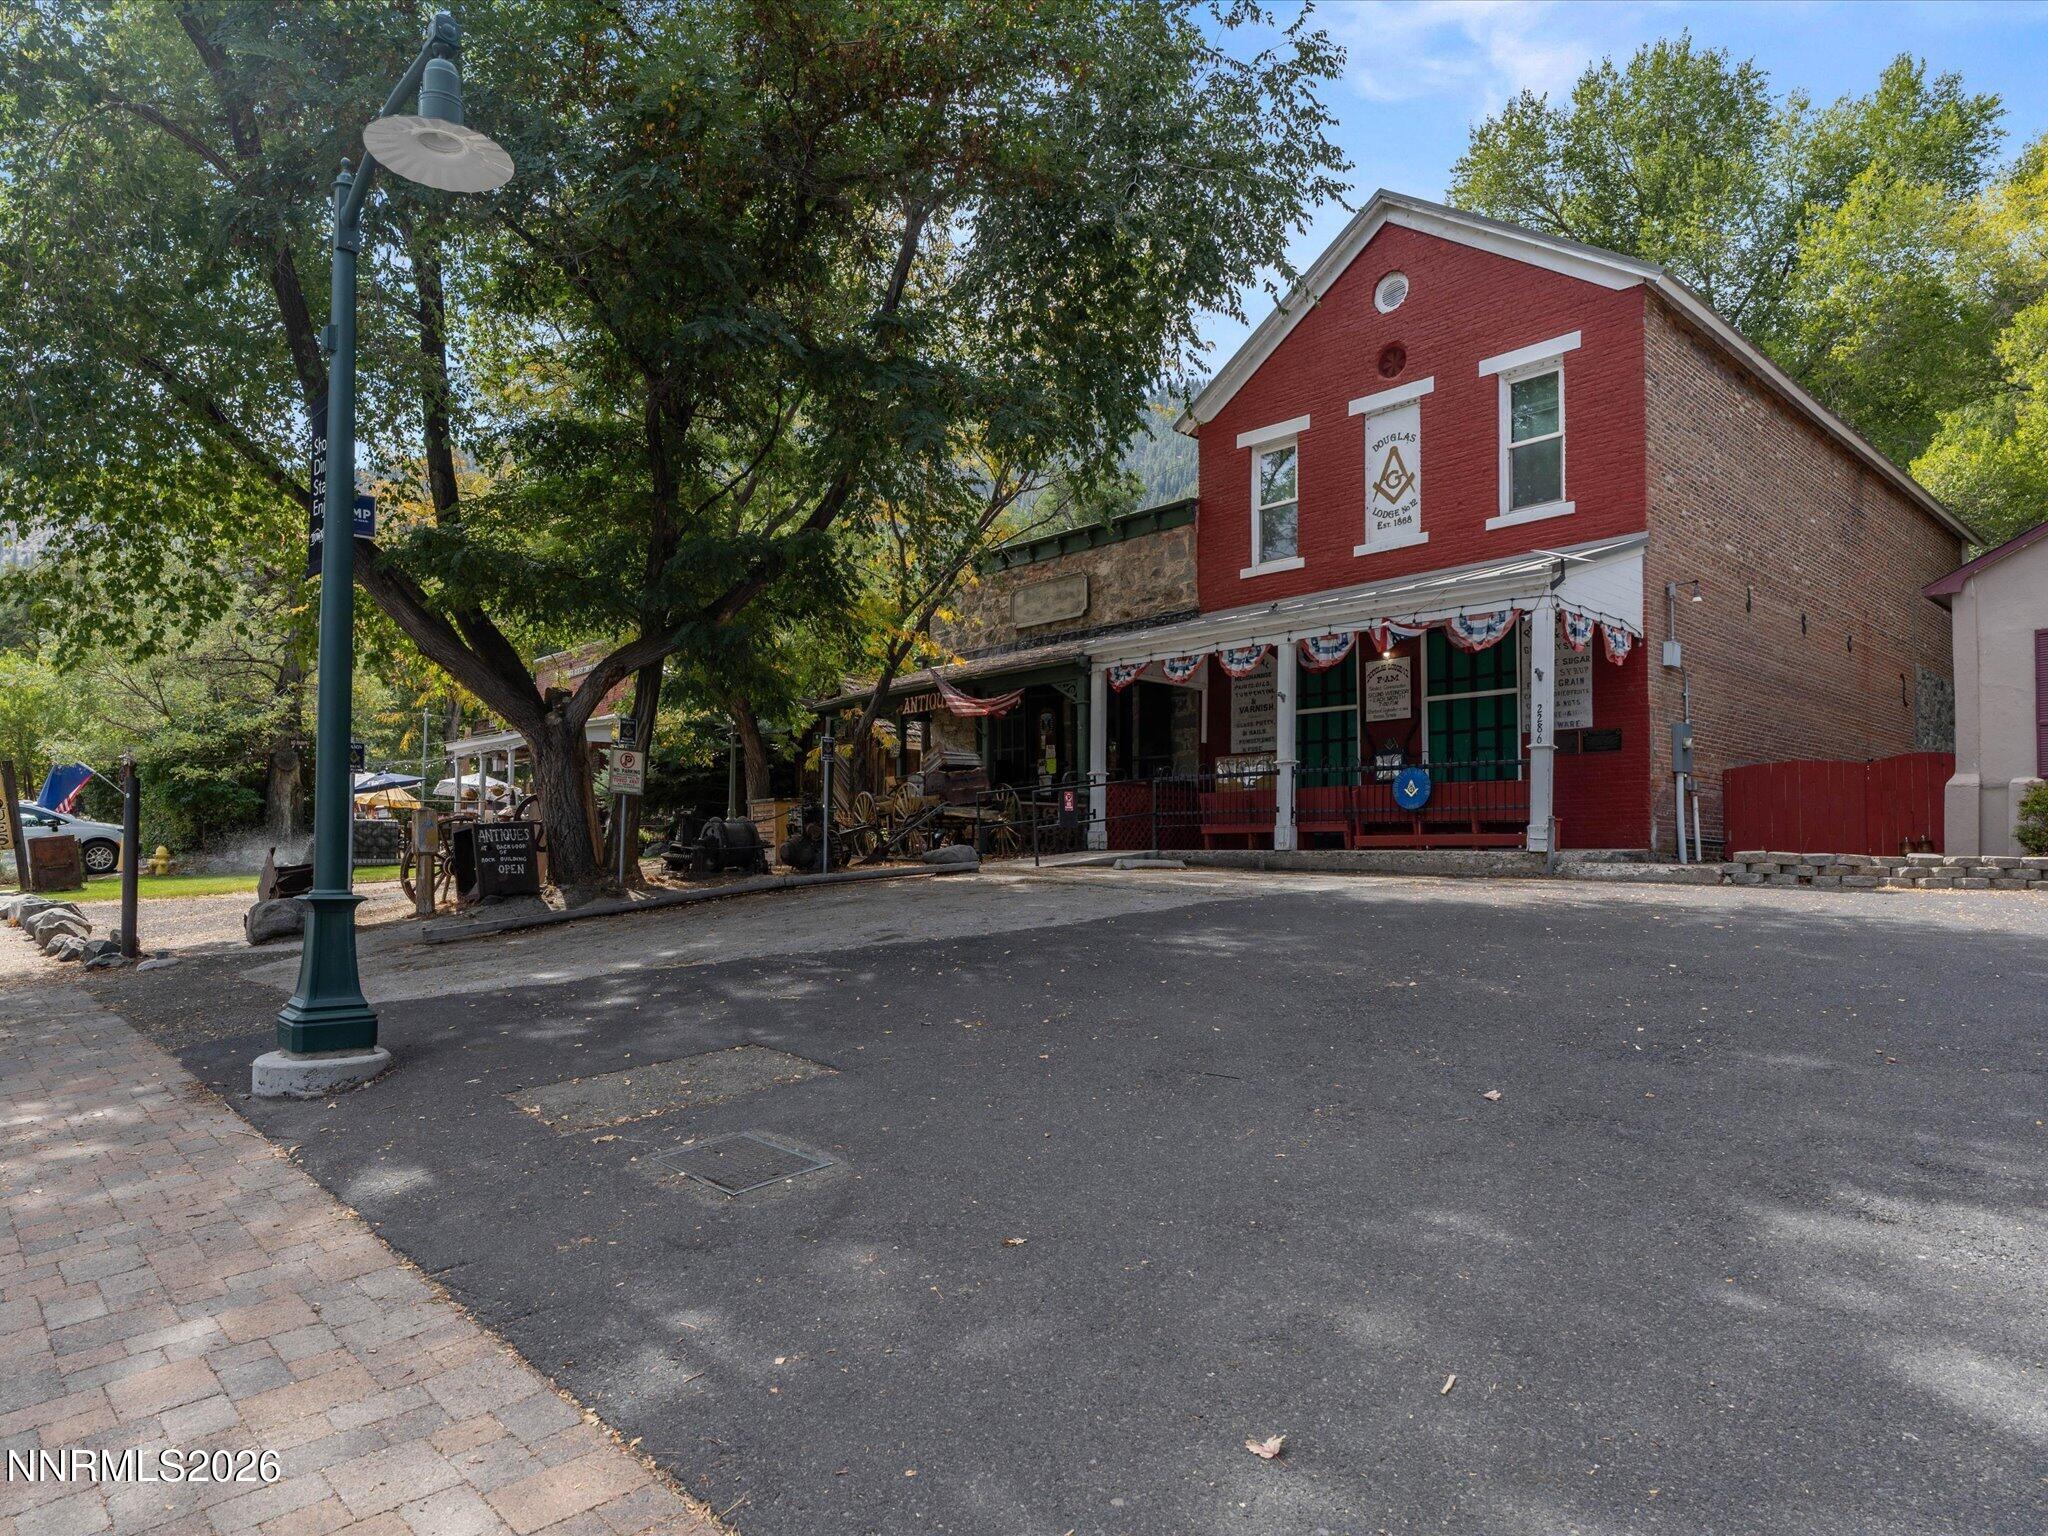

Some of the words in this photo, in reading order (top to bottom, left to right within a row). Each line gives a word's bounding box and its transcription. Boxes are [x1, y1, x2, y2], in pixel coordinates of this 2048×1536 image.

[313, 436, 327, 455] Sho
[1372, 432, 1417, 453] DOUGLAS
[313, 457, 326, 475] Din
[1385, 469, 1402, 489] G
[313, 479, 326, 496] Sta
[313, 498, 326, 518] Enj
[353, 508, 371, 519] MP
[1372, 506, 1400, 519] LODGE
[1409, 498, 1418, 508] 12
[1394, 514, 1413, 527] 1868
[1562, 656, 1591, 666] SUGAR
[1559, 666, 1590, 677] SYRUP
[1558, 677, 1585, 687] GRAIN
[902, 692, 945, 715] ANTIQU
[1239, 703, 1275, 714] VARNISH
[1556, 720, 1585, 728] WARE.
[478, 828, 530, 843] ANTIQUES
[498, 864, 525, 874] OPEN
